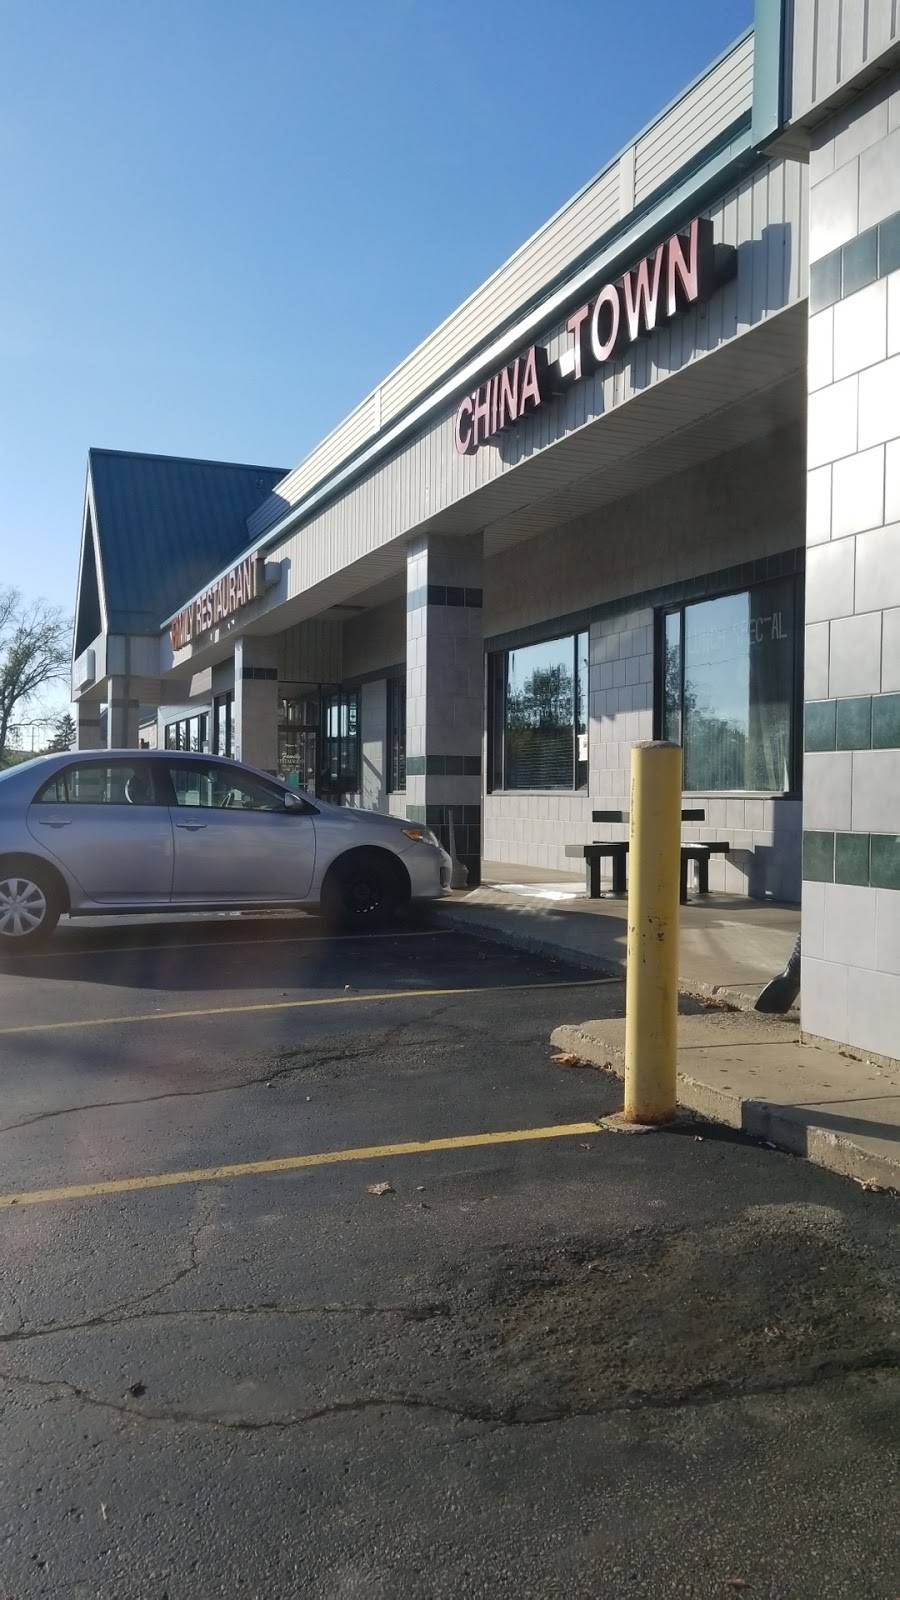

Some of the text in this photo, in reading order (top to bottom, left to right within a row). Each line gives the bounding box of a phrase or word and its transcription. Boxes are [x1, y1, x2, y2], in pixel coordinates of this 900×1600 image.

[455, 216, 699, 455] CHINA TOWN
[196, 550, 259, 636] RESTAURANT
